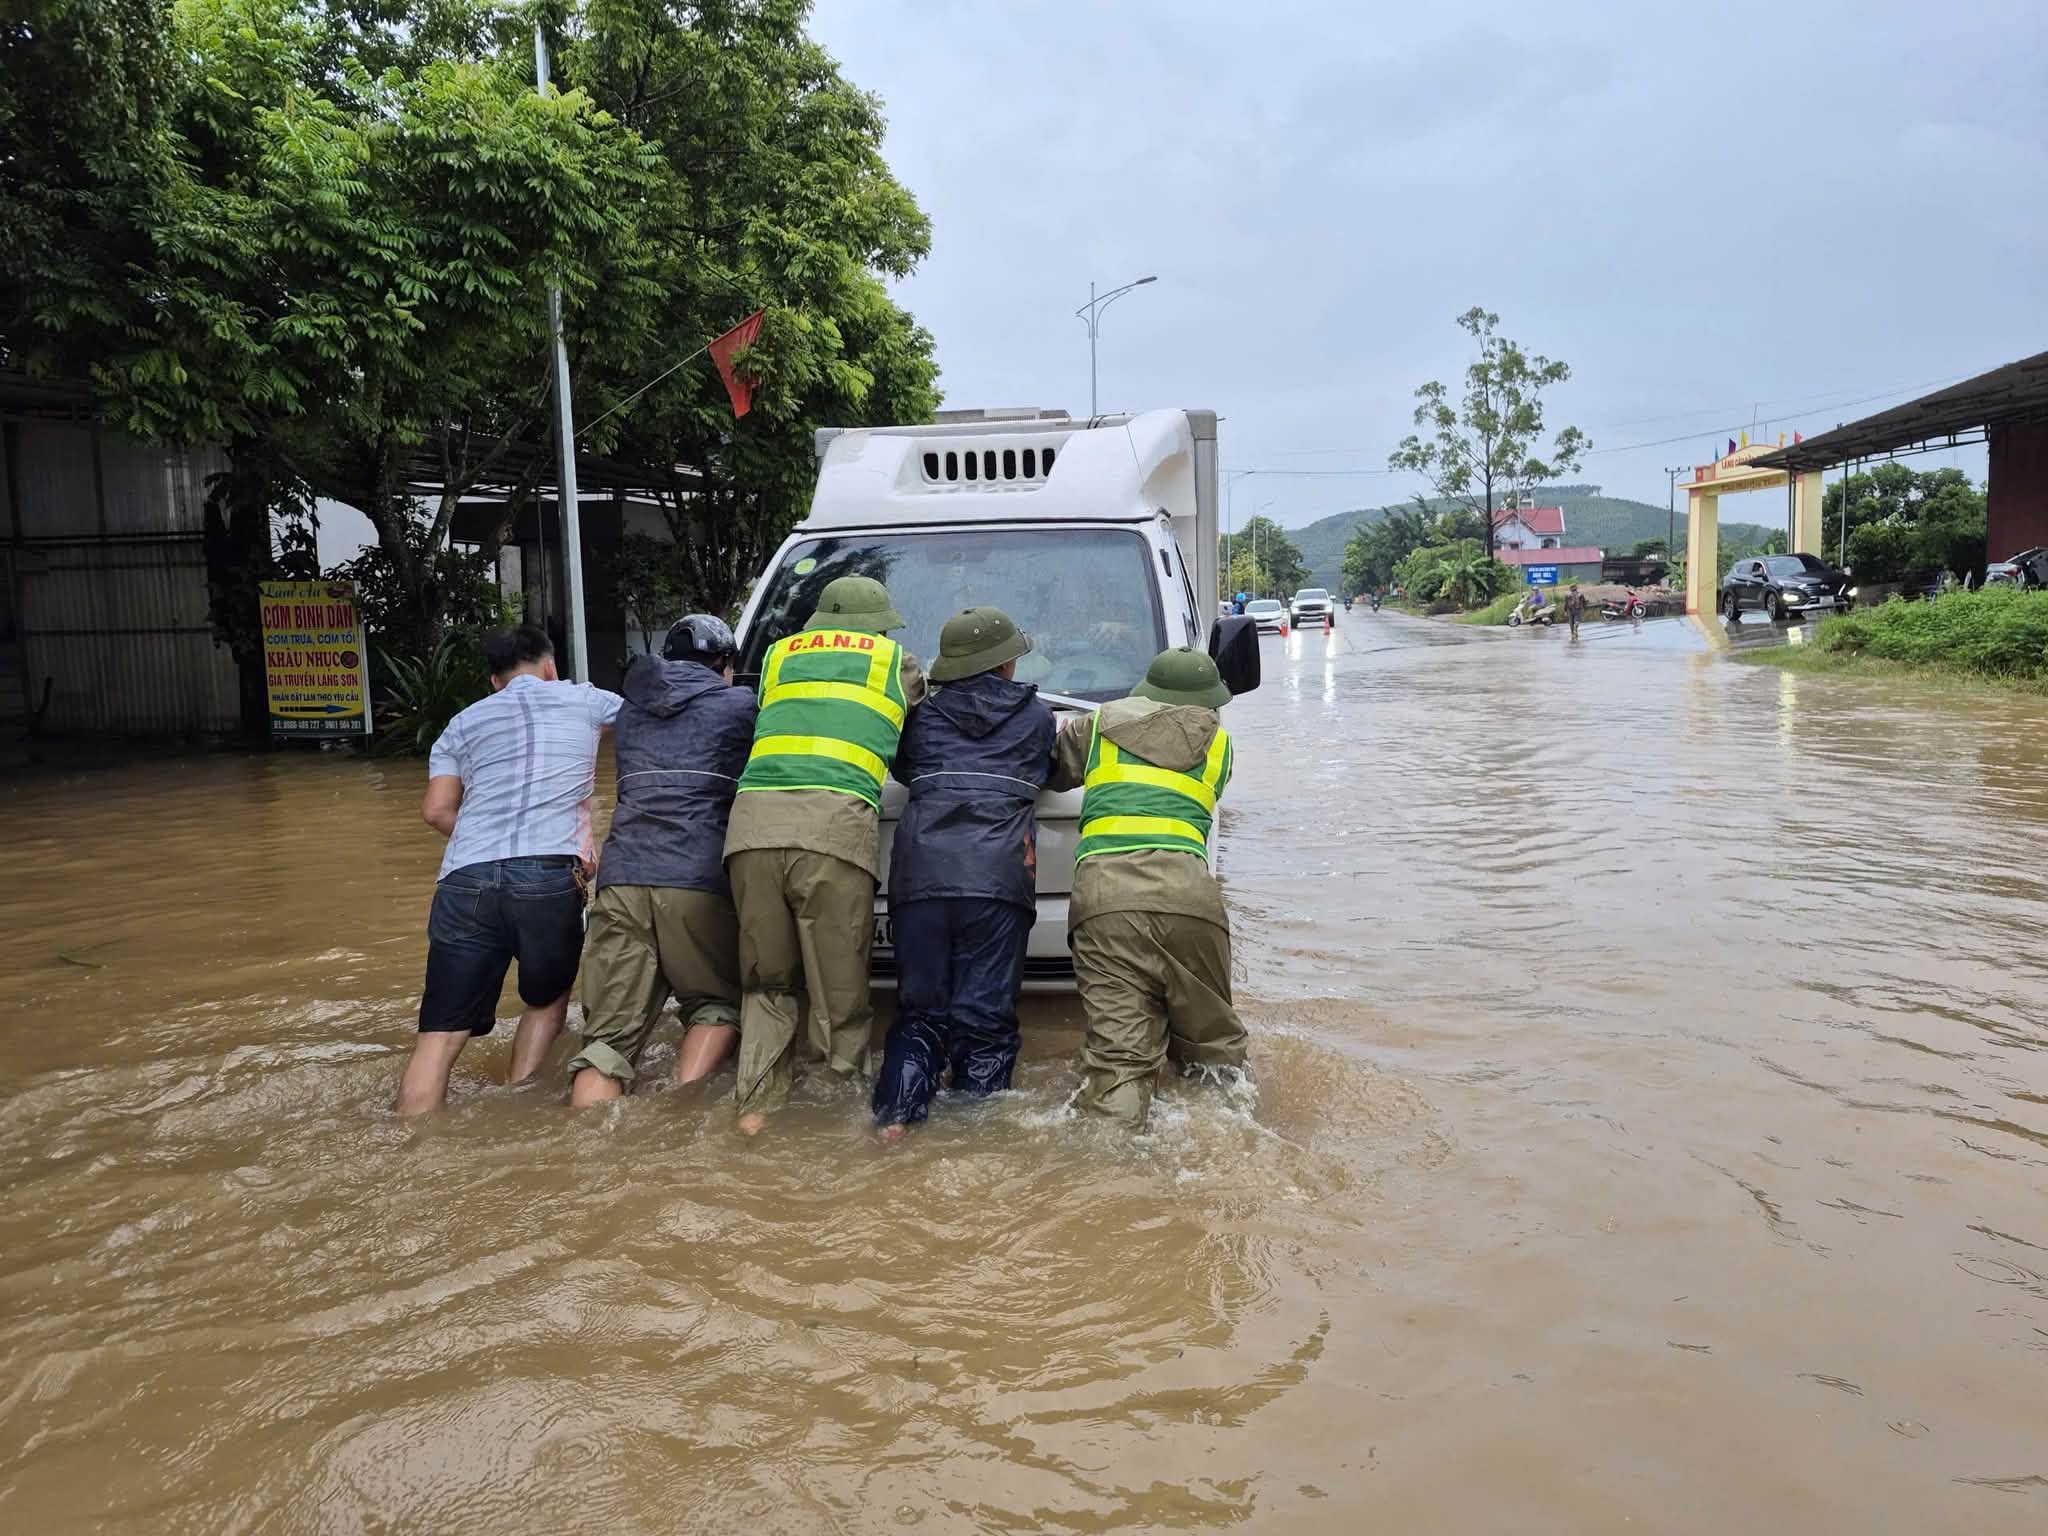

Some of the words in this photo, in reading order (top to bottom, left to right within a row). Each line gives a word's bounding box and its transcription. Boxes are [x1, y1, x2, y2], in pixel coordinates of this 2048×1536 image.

[264, 603, 291, 629] CƠM
[295, 599, 324, 629] BÌNH
[328, 599, 353, 629] DÂN
[789, 634, 874, 652] C.A.N.D
[306, 651, 340, 672] NHỤC
[269, 673, 282, 687] GIA
[341, 673, 358, 687] SƠN
